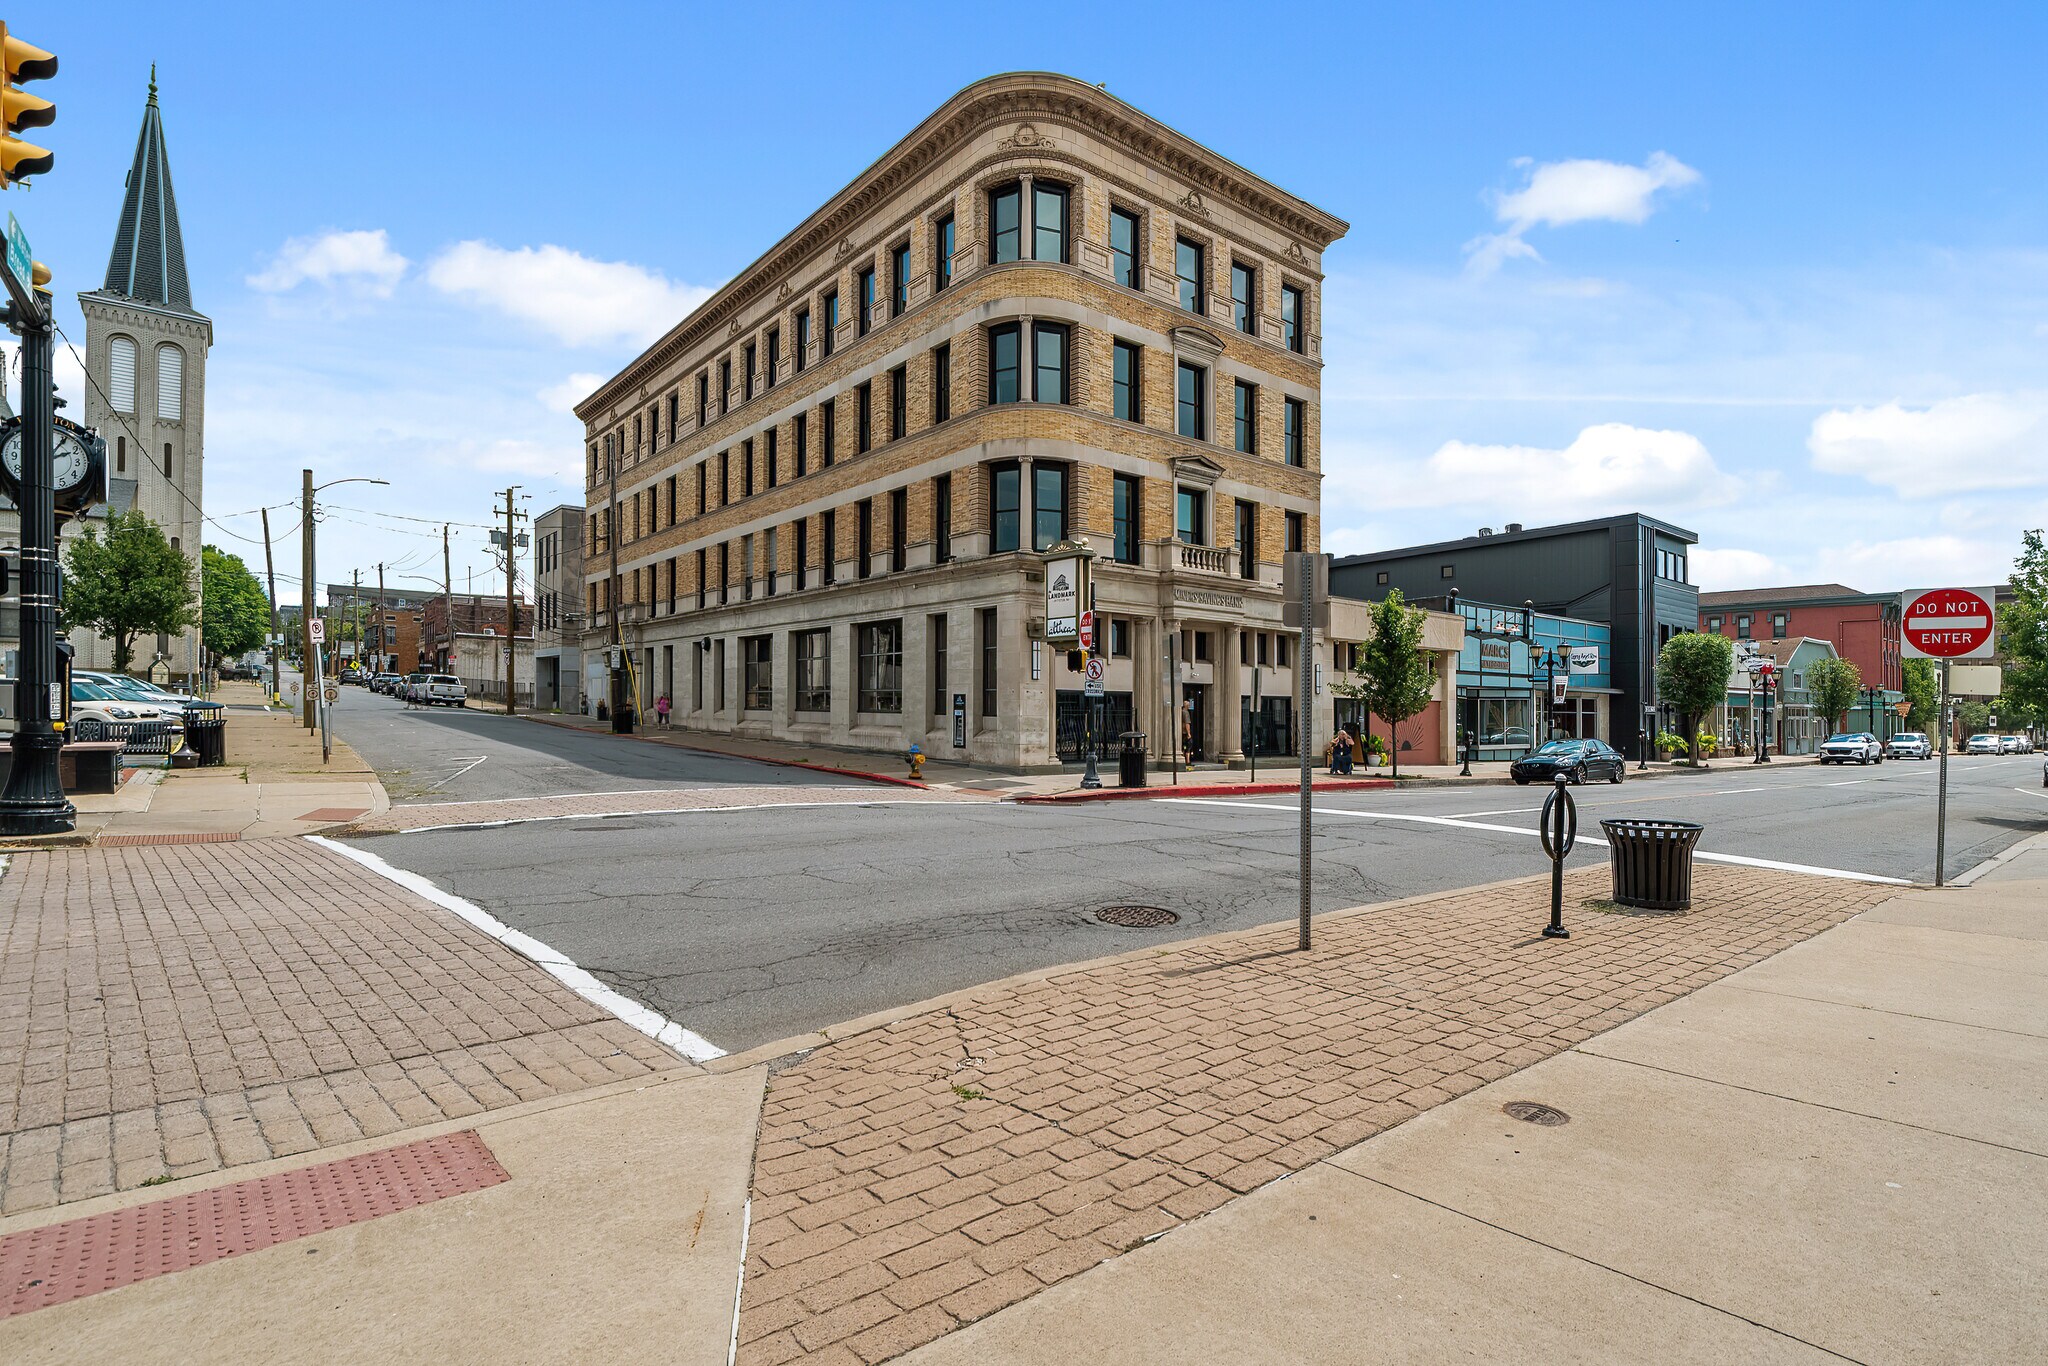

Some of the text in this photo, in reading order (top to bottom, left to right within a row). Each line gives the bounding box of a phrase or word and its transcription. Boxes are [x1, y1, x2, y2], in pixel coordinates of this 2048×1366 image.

[73, 446, 79, 455] 2
[11, 452, 17, 460] 9
[75, 459, 80, 467] 3
[14, 464, 21, 474] 8
[71, 470, 77, 479] 4
[59, 478, 66, 487] 5
[1048, 590, 1076, 600] LANDMARK
[1916, 601, 1979, 614] DO NOT
[1922, 632, 1972, 644] ENTER
